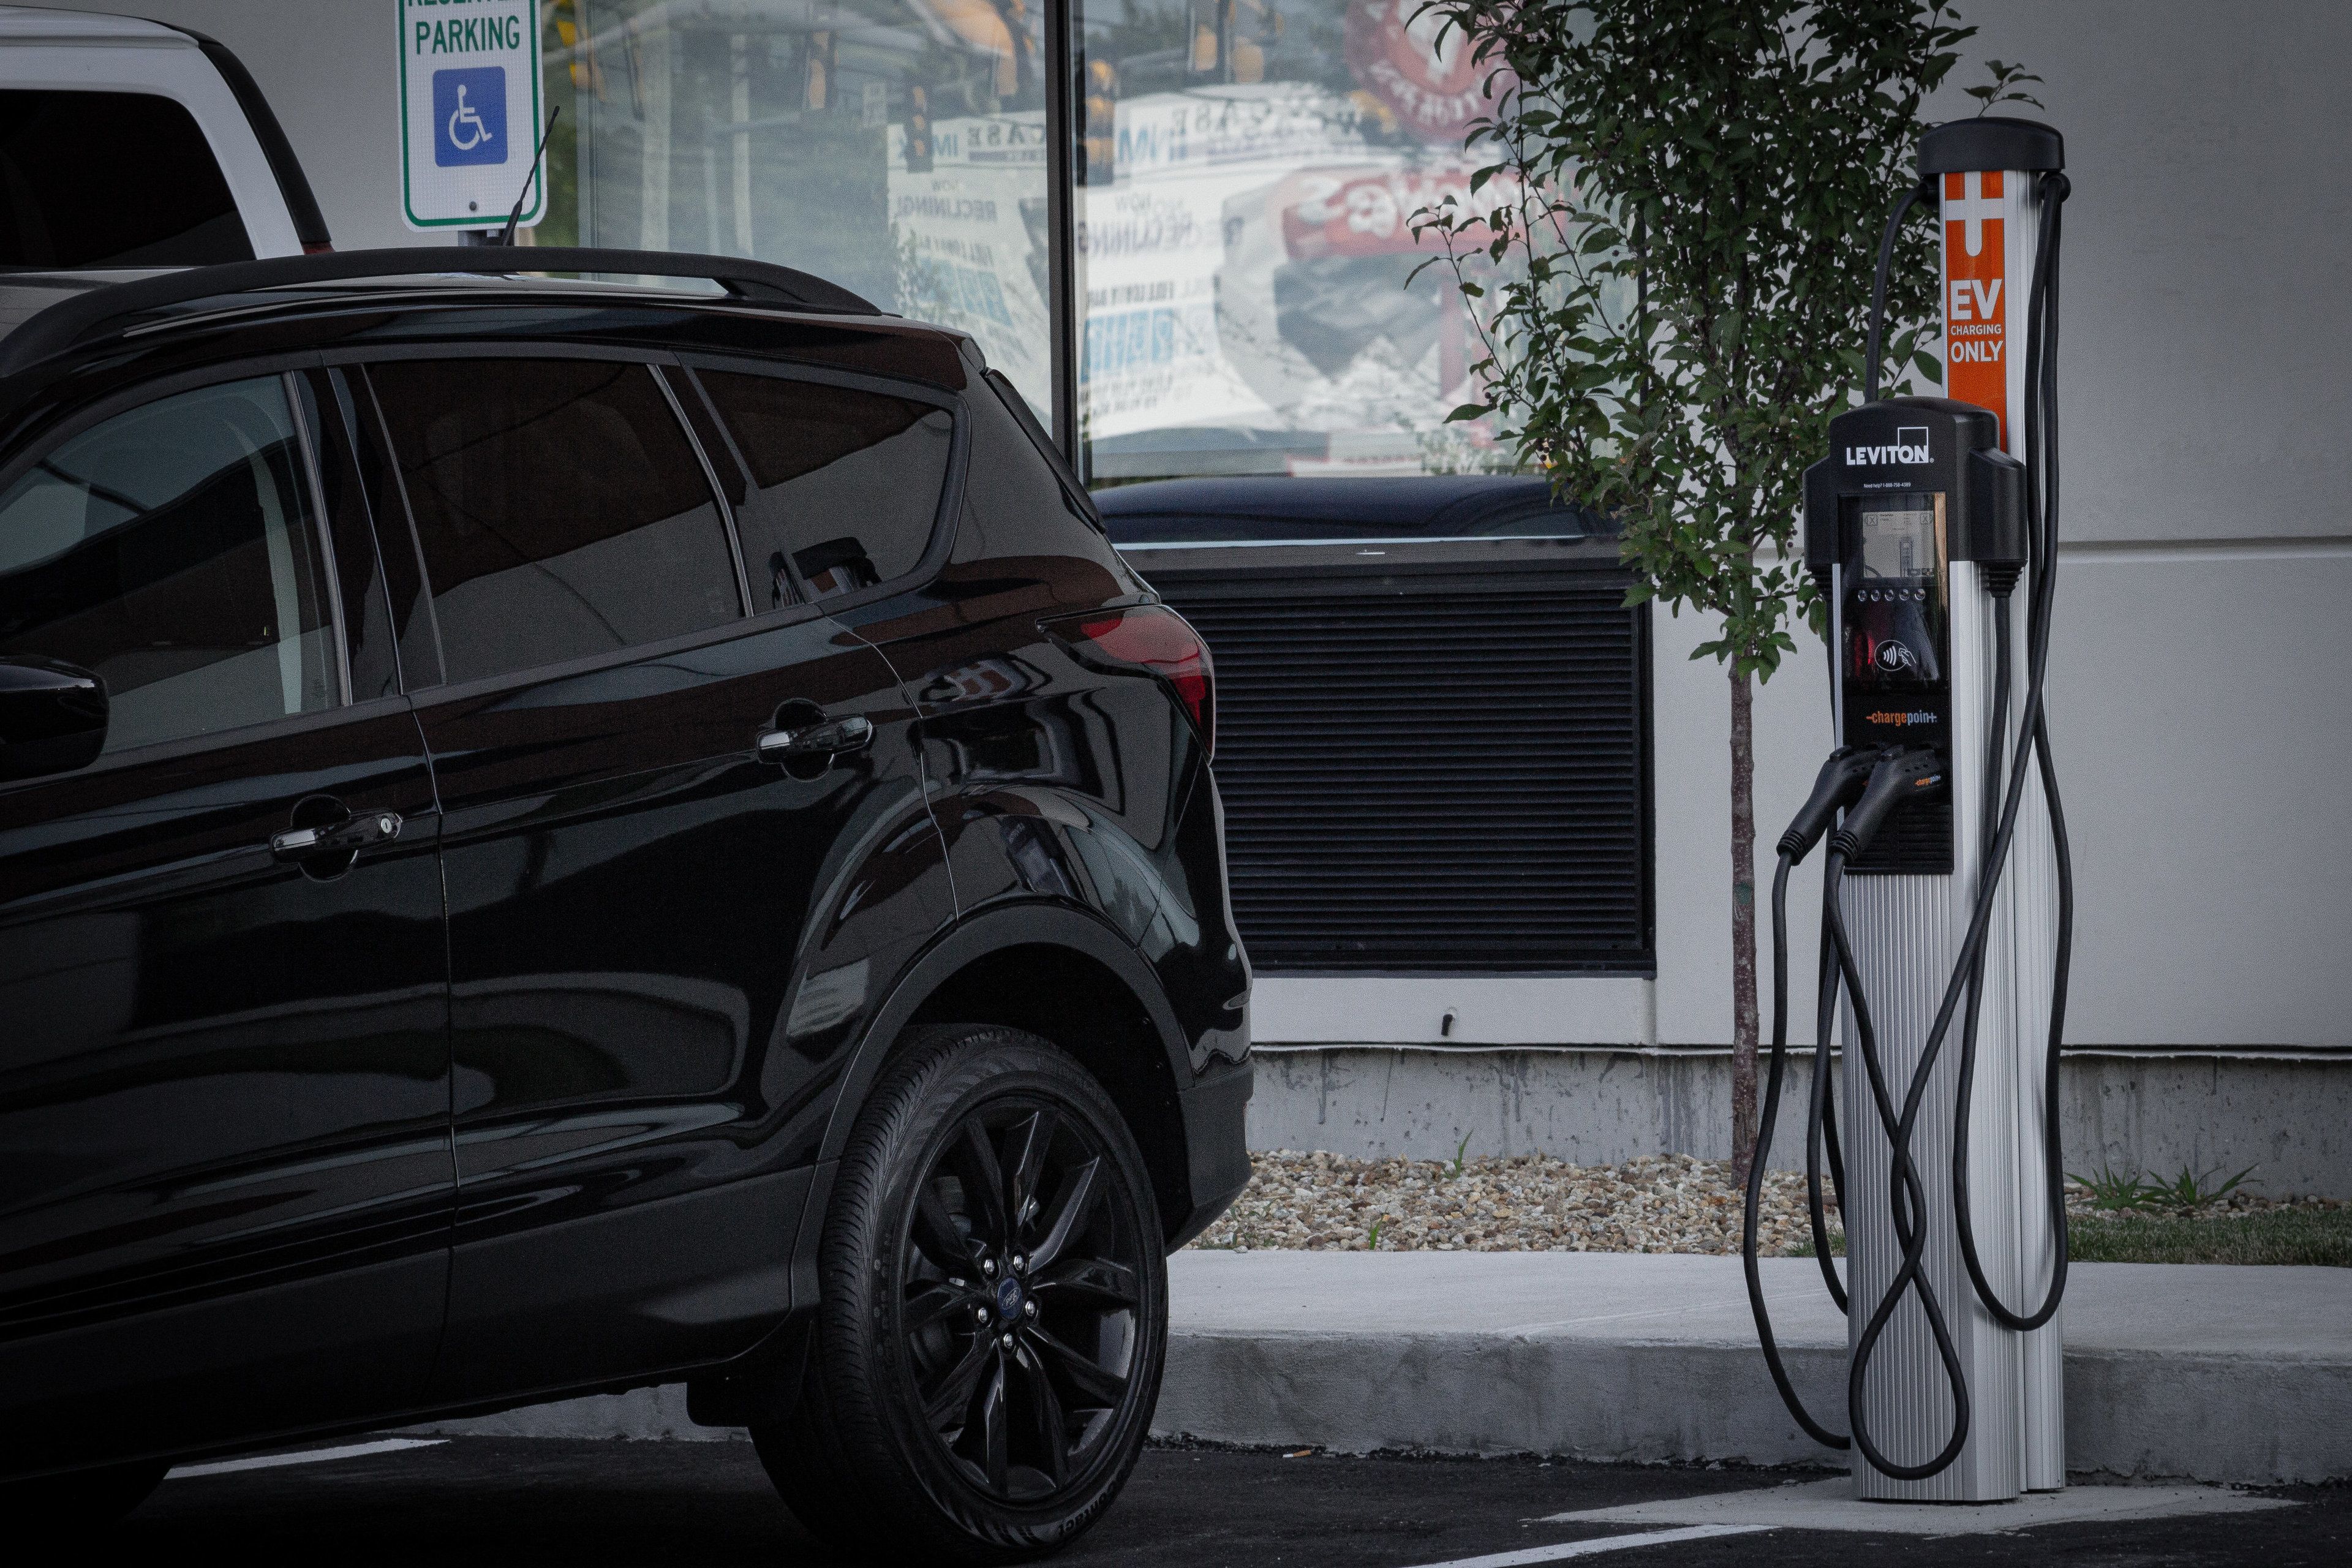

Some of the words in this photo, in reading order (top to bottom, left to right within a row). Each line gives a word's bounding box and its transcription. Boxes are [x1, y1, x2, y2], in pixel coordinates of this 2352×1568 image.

[415, 15, 520, 55] PARKING
[1951, 279, 2002, 320] EV
[1951, 324, 2002, 336] CHARGING
[1951, 340, 2003, 363] ONLY
[1846, 445, 1929, 466] LEVITON
[1866, 709, 1937, 727] chargepoint
